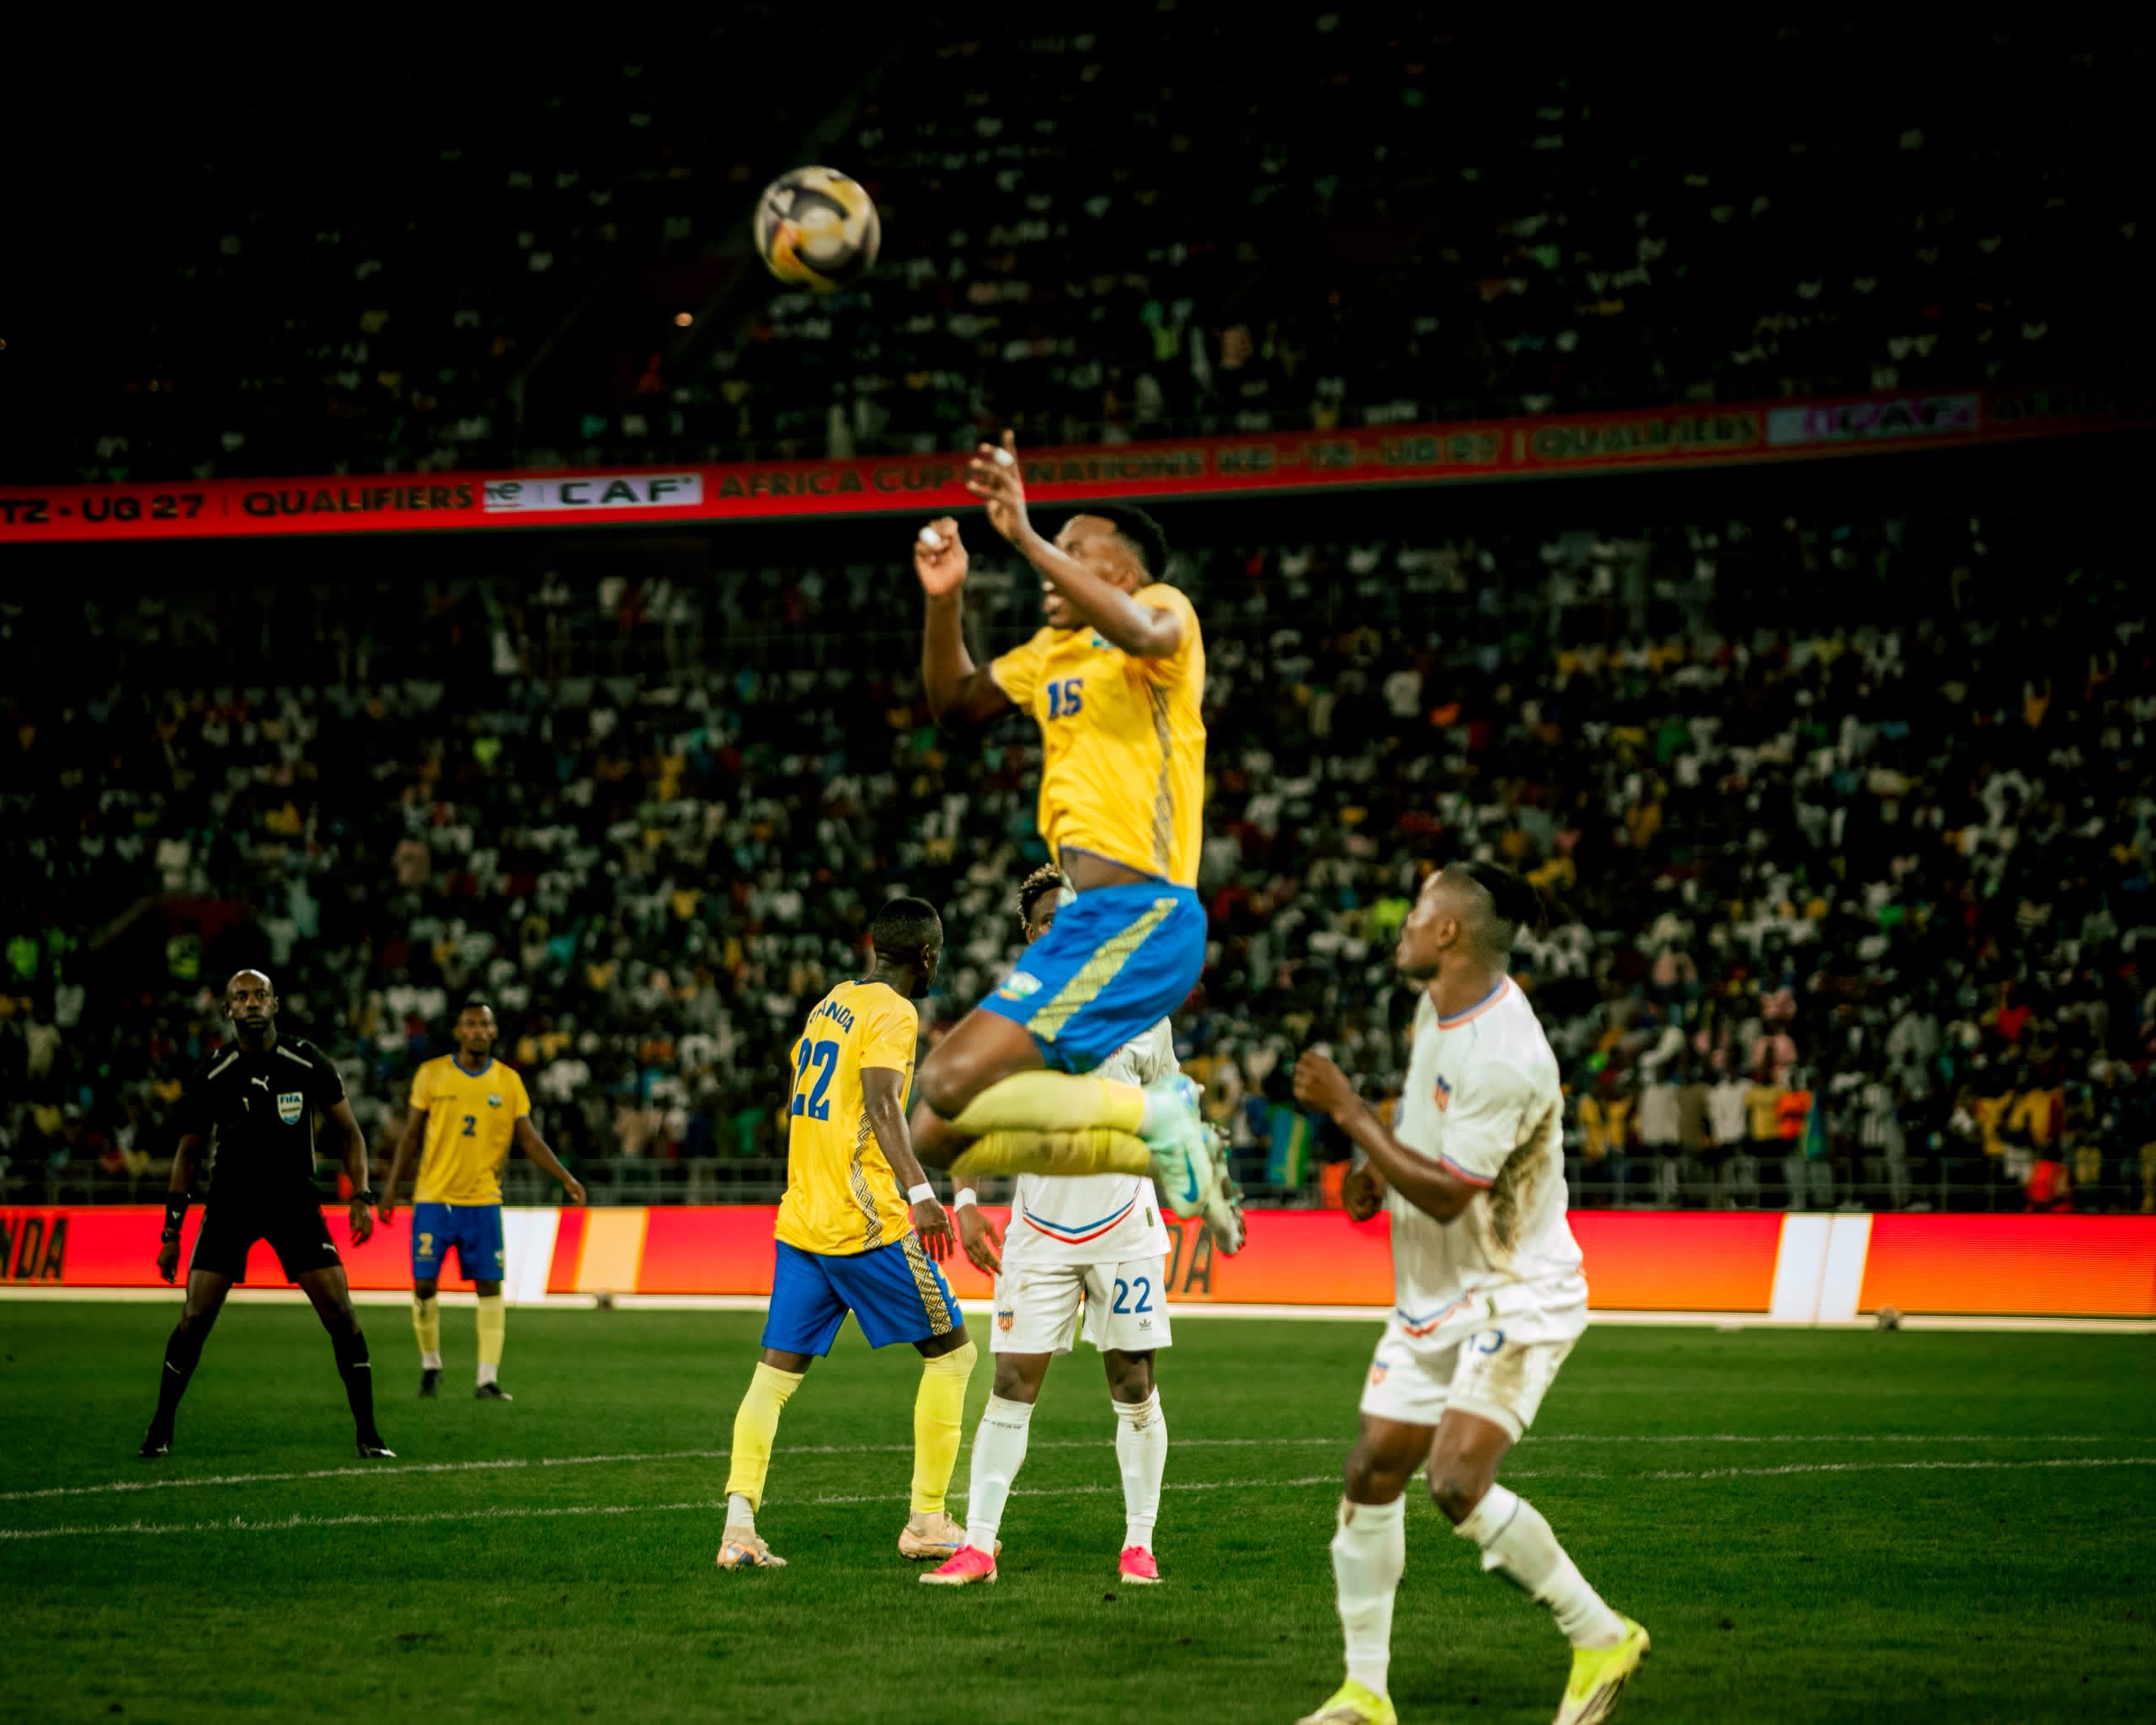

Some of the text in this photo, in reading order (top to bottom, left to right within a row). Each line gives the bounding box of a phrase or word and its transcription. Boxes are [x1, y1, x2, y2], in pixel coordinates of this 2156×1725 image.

[718, 467, 867, 499] AFRICA
[872, 464, 956, 492] CUP
[1024, 451, 1203, 483] NATIONS
[243, 483, 473, 517] QUALIFIERS
[559, 478, 682, 505] CAF
[0, 499, 49, 523] TZ
[83, 496, 141, 522] UG
[152, 494, 205, 519] 27
[1047, 677, 1085, 722] 15
[792, 1037, 841, 1122] 22
[280, 1094, 301, 1104] FIFA
[462, 1114, 478, 1137] 2
[418, 1232, 434, 1256] 2
[1113, 1276, 1154, 1315] 22
